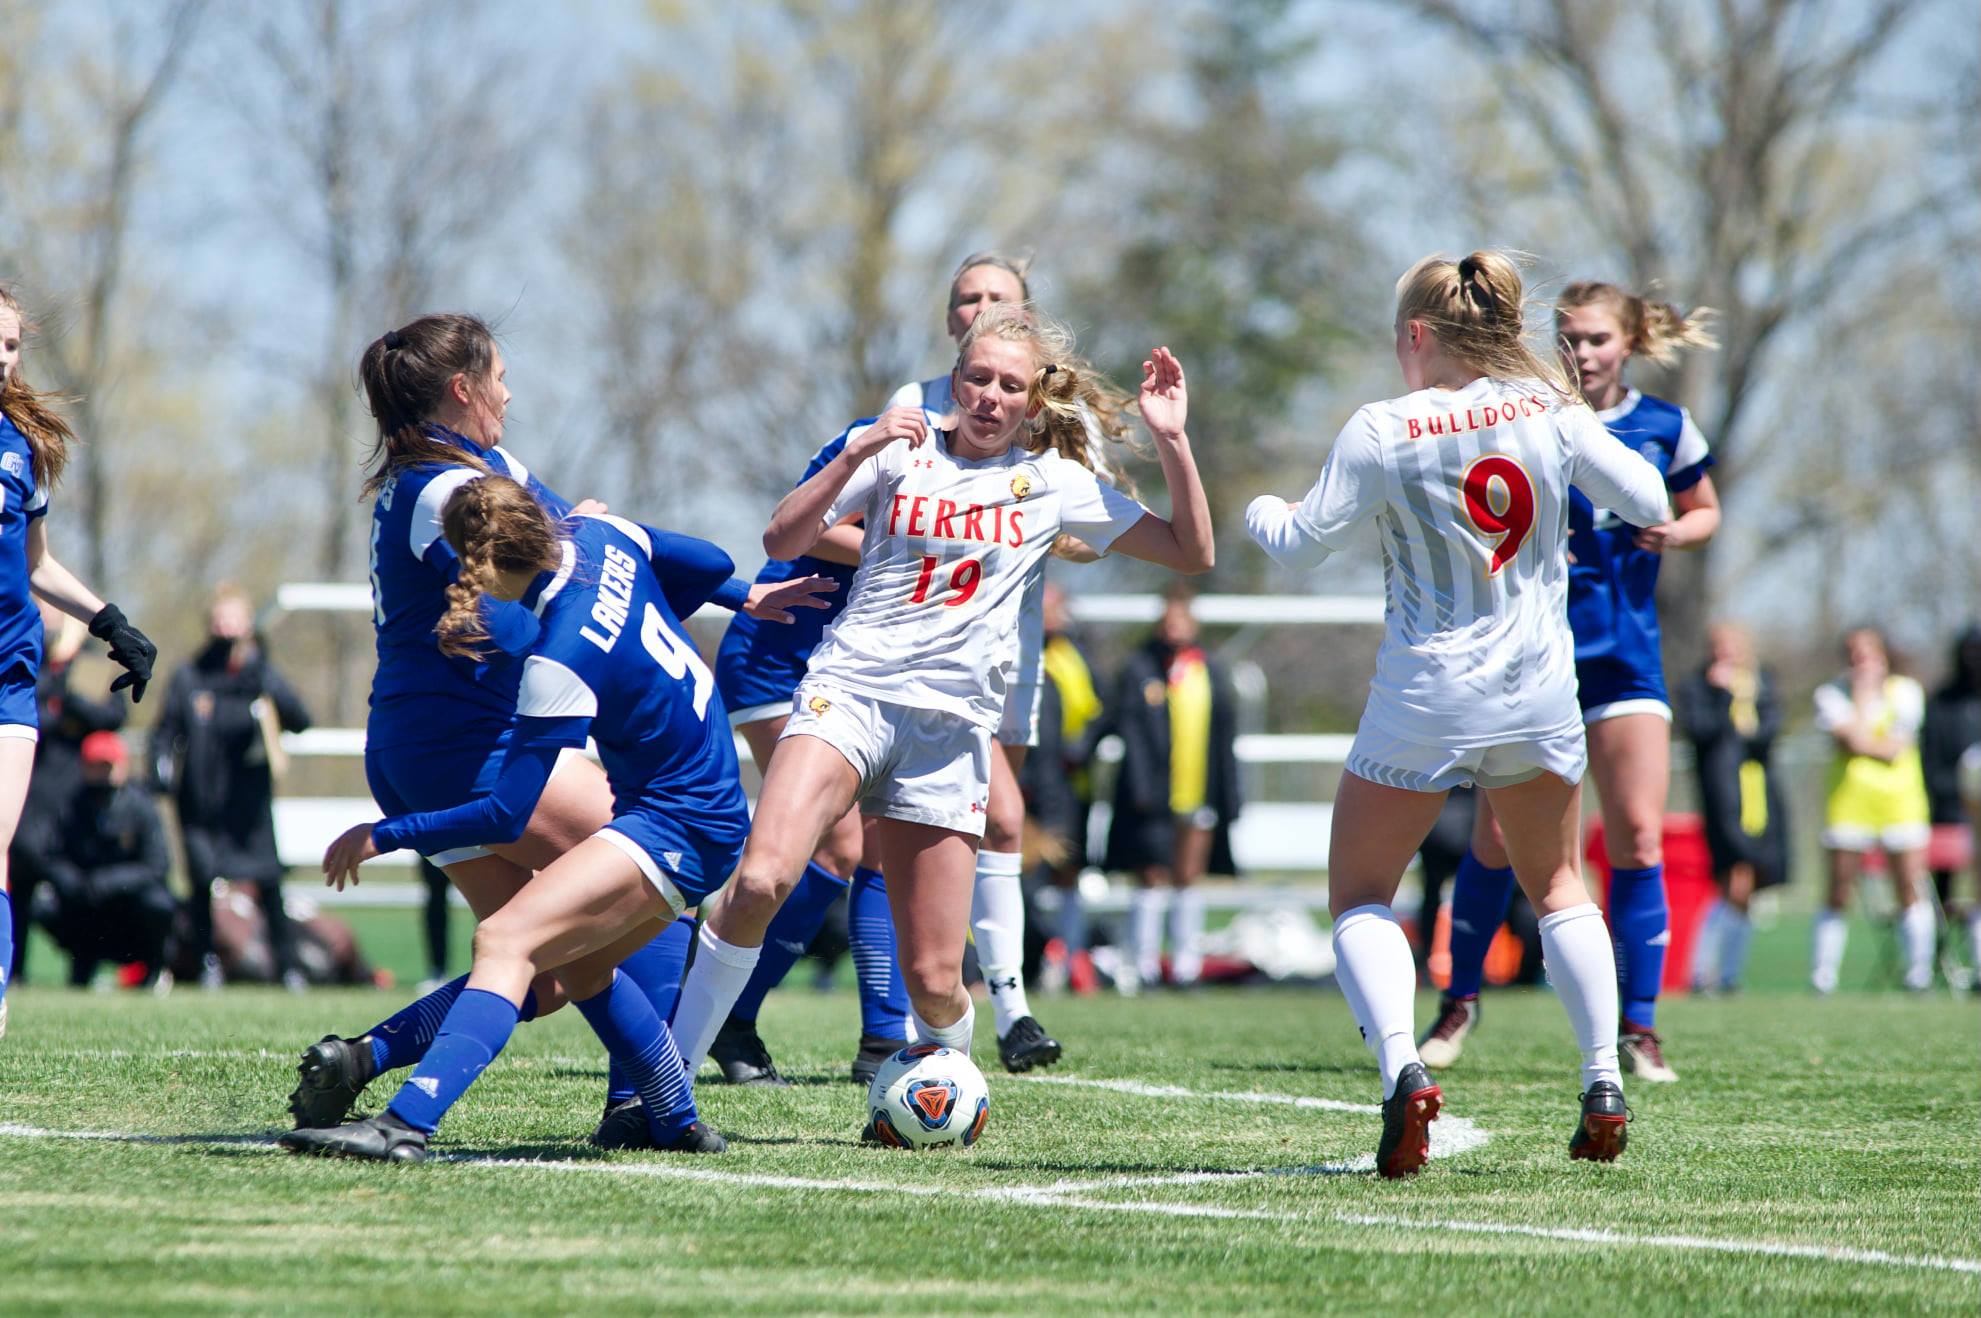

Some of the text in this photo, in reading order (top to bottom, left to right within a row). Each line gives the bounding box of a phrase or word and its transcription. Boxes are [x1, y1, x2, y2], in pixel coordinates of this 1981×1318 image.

[1407, 395, 1548, 440] BULLDOGS
[888, 494, 1024, 549] FERRIS
[1459, 453, 1538, 578] 9
[579, 544, 637, 654] LAKERS
[909, 555, 983, 608] 19
[640, 602, 714, 722] 9
